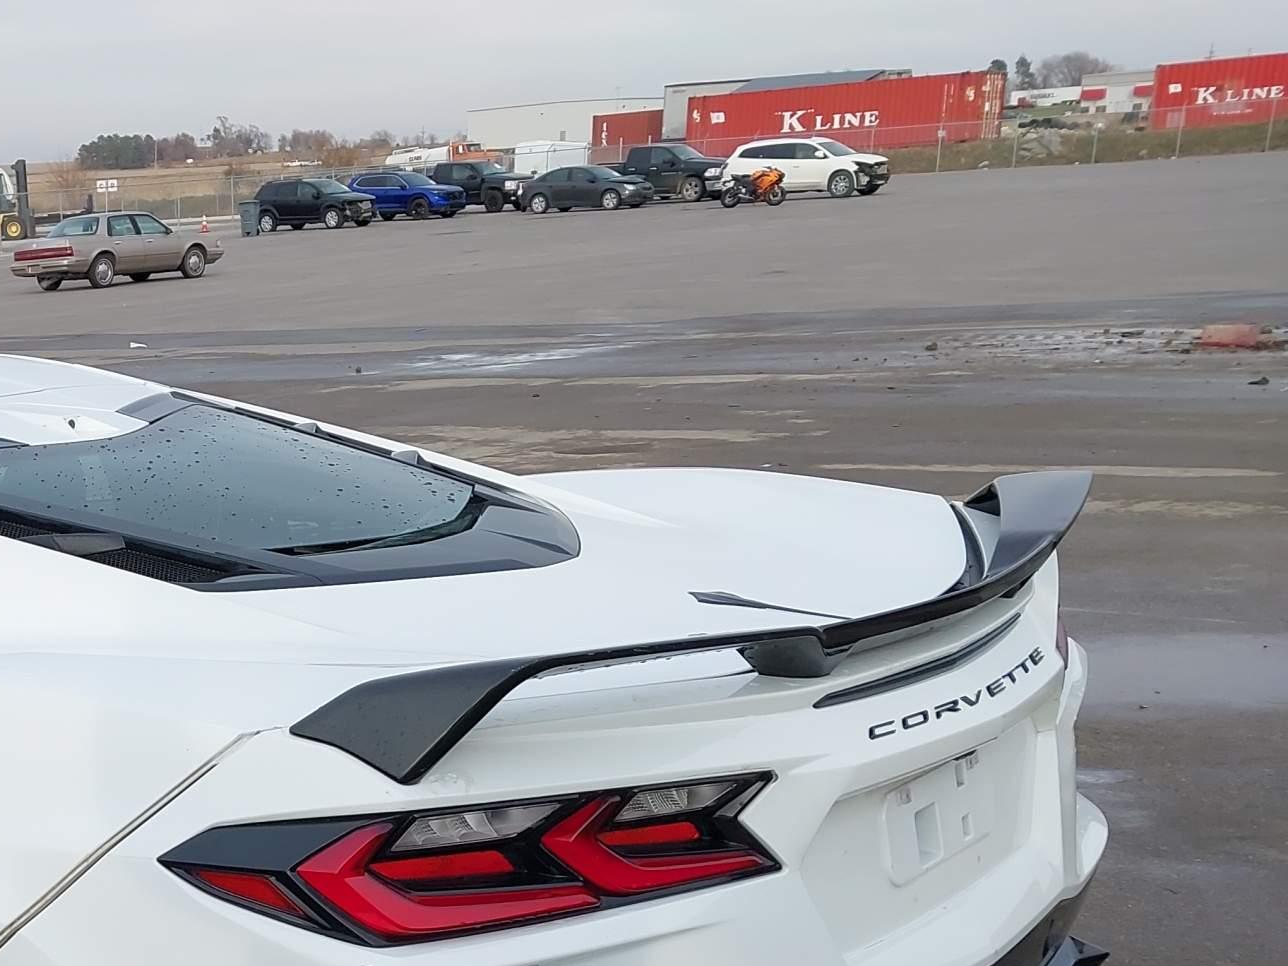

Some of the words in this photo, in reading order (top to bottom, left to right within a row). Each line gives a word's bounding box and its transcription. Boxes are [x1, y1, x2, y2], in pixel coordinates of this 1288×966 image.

[1225, 85, 1285, 102] LINE
[815, 110, 881, 131] LINE
[868, 646, 1046, 741] CORVETTE
